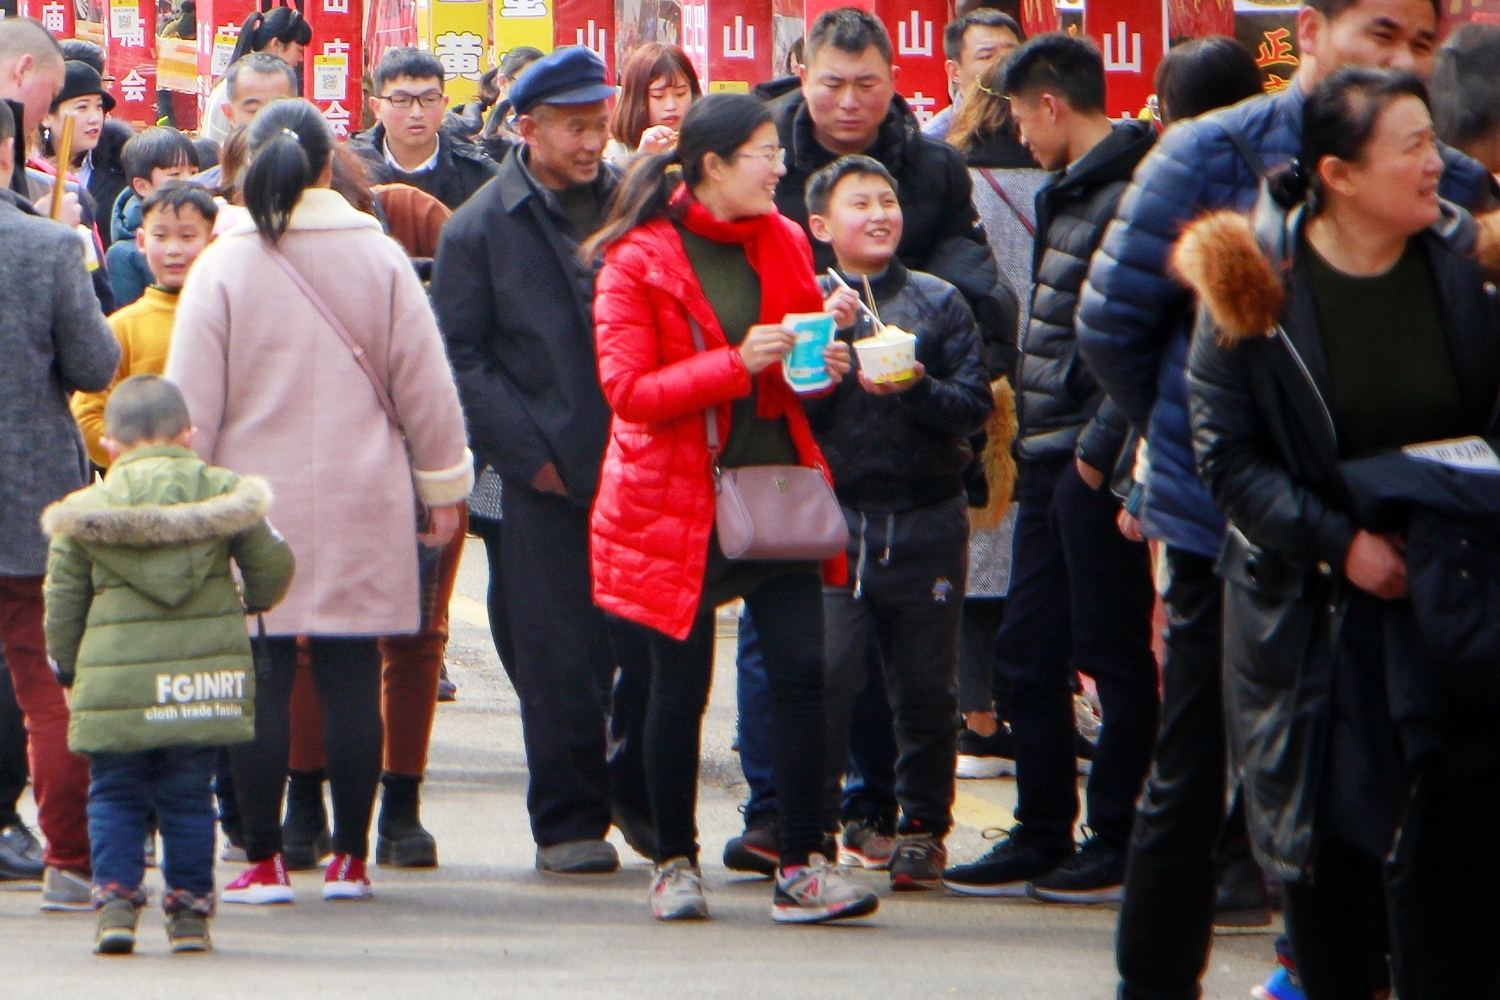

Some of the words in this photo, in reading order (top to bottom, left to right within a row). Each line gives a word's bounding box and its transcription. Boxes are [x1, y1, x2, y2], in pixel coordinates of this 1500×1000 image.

[156, 670, 247, 704] FGINRT
[145, 706, 178, 721] cloth
[182, 704, 213, 719] trade
